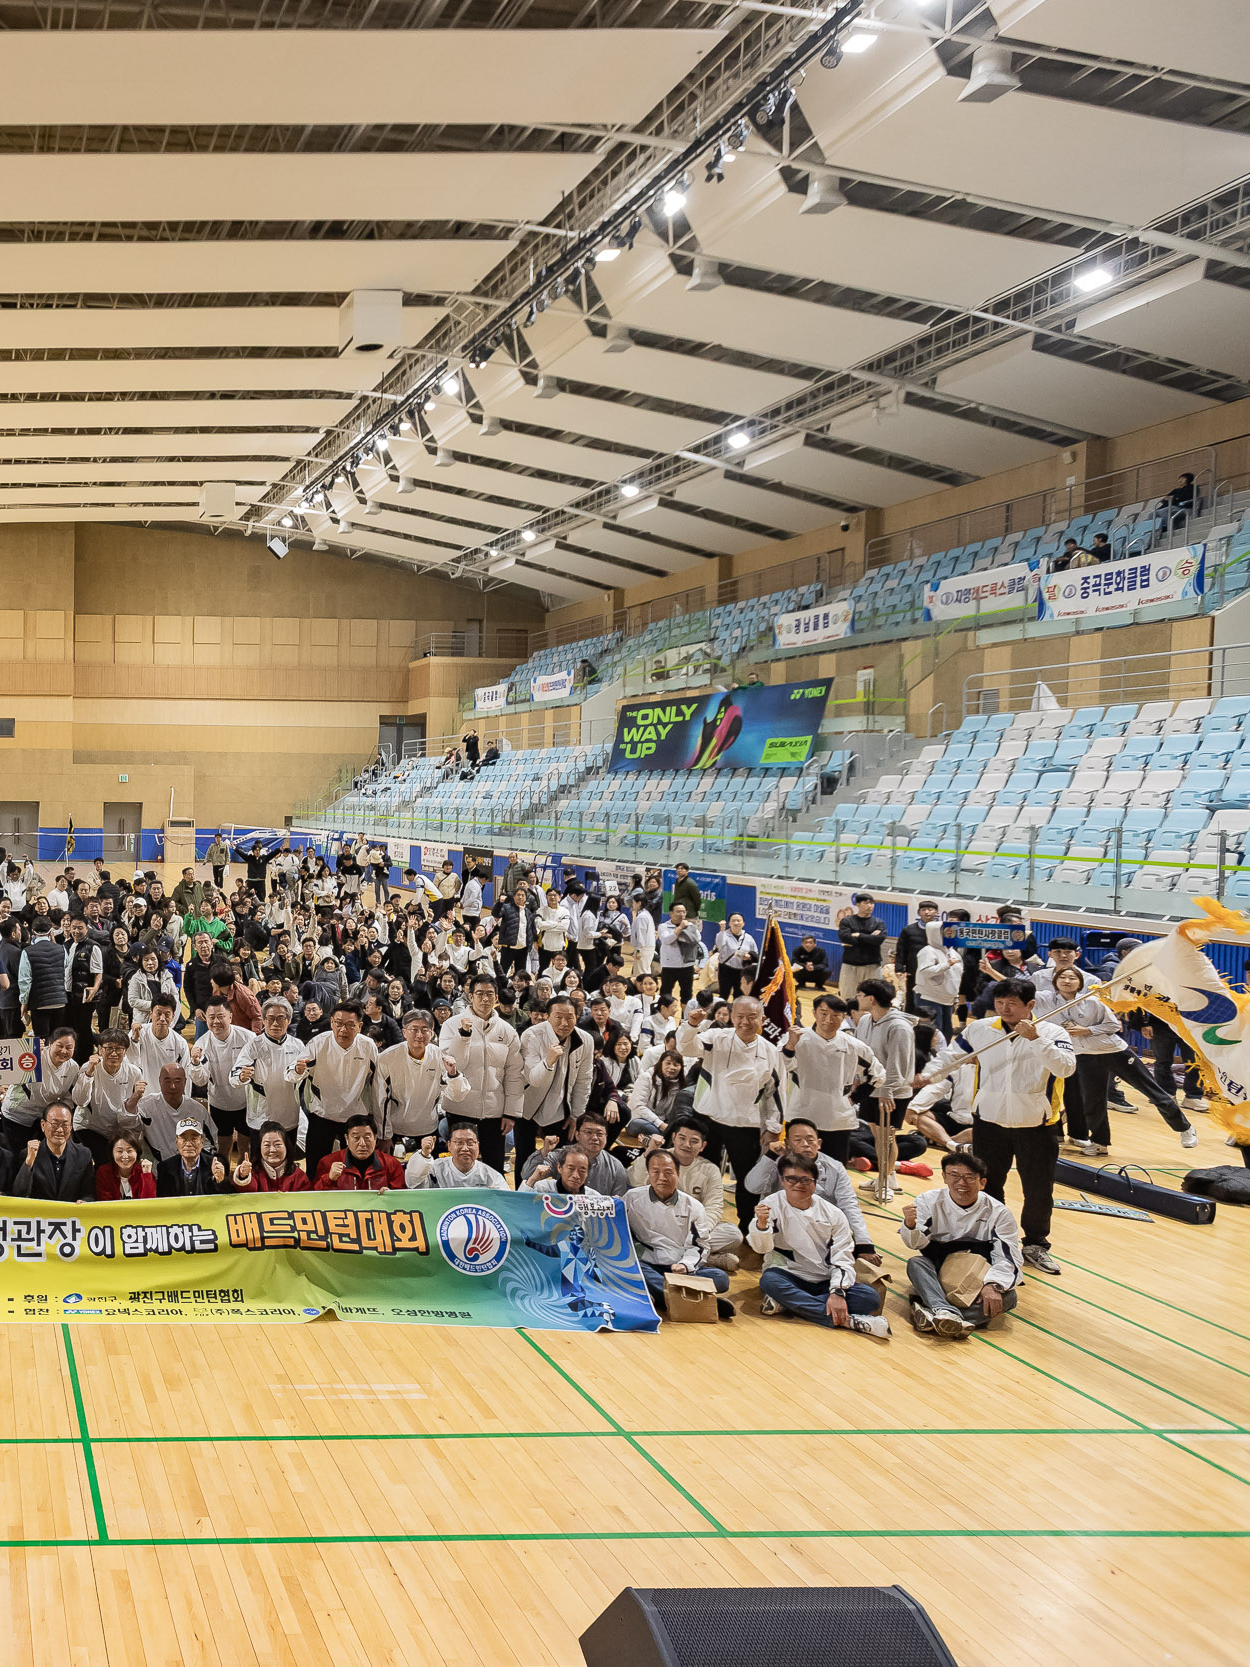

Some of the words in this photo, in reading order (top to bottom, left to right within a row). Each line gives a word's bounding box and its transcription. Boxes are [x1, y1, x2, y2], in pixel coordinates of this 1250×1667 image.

[1080, 563, 1151, 599] 중곡문화클럽
[1179, 559, 1195, 576] 승
[804, 686, 827, 699] YONEX
[636, 703, 698, 726] ONLY
[623, 724, 673, 742] WAY
[625, 743, 656, 759] UP
[21, 1056, 34, 1068] 승
[578, 1202, 614, 1216] 행복광진
[442, 1212, 457, 1240] BADMINTON
[457, 1208, 477, 1216] KOREA
[478, 1209, 507, 1241] ASSOCIATION
[87, 1226, 113, 1257] 이
[121, 1225, 217, 1258] 함께하는
[226, 1209, 430, 1256] 배드민턴대회
[454, 1258, 498, 1272] 대한배드민턴협회
[23, 1294, 49, 1304] 후원
[128, 1289, 245, 1304] 광진구배드민턴협회
[24, 1307, 50, 1316] 협찬
